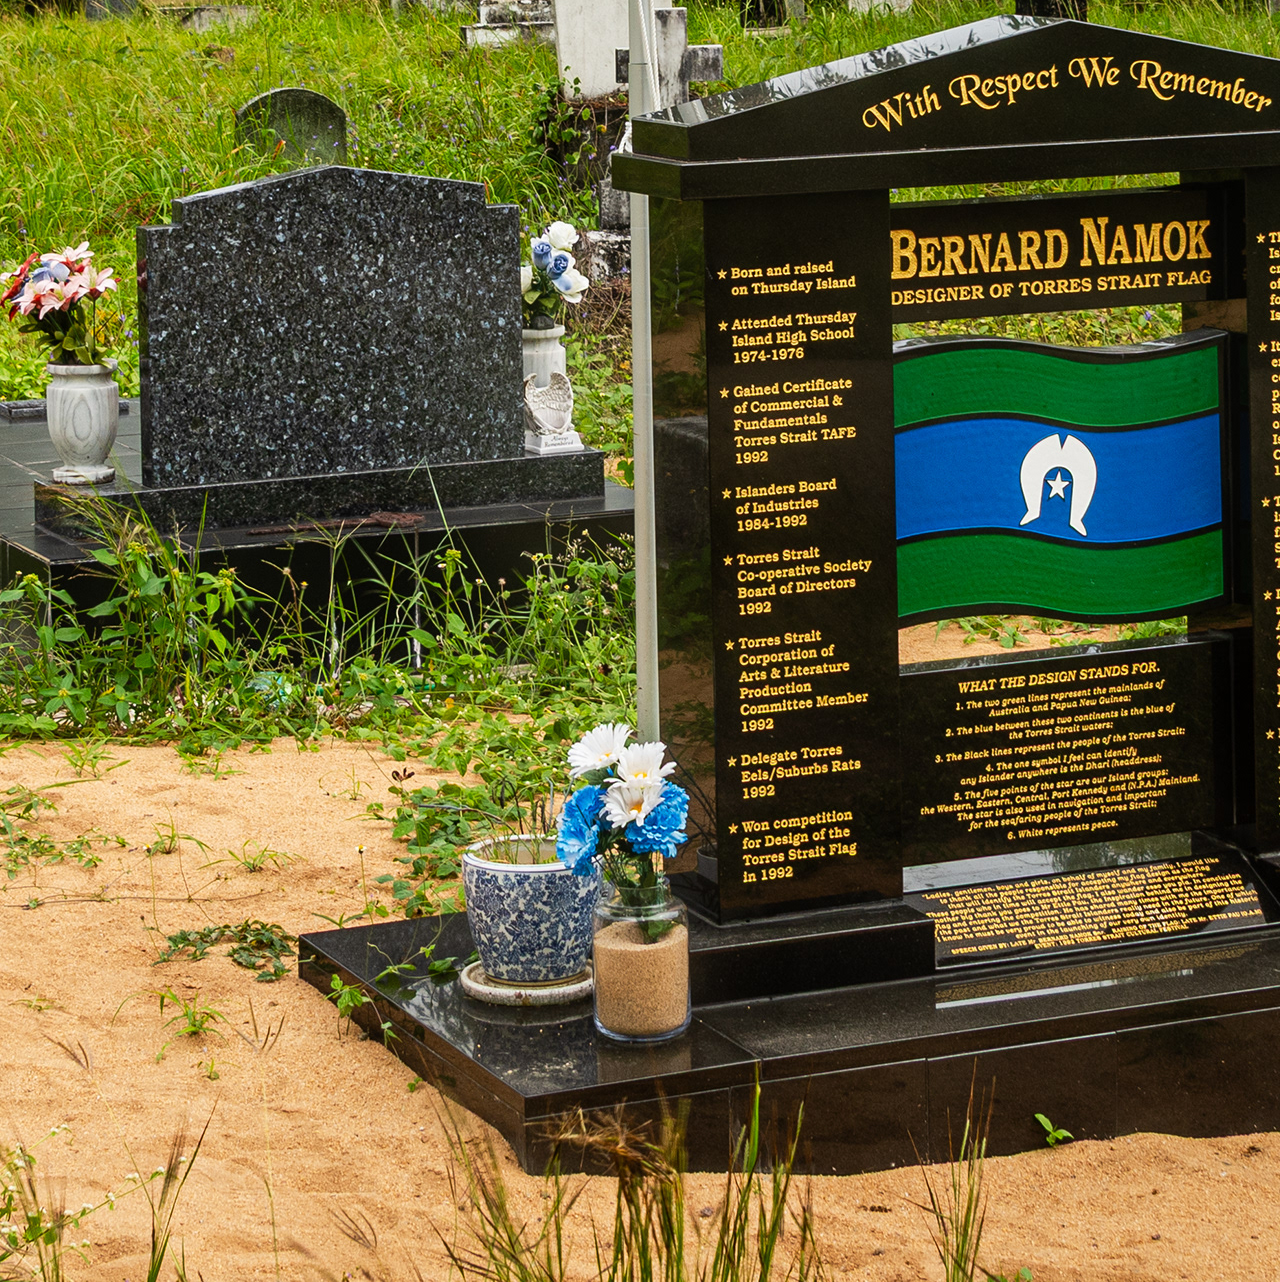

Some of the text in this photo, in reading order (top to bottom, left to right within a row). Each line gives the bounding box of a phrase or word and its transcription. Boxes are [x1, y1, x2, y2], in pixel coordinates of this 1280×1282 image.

[863, 56, 1272, 132] With Respect We Remember
[890, 216, 1212, 279] BERNARD NAMOK
[730, 260, 834, 278] Born and raised
[731, 275, 856, 295] on Thursday Island
[891, 270, 1212, 305] DESIGNER OF TORRES STRAIT FLAG
[731, 310, 856, 330] Attended Thursday
[732, 326, 854, 346] Island High School
[734, 346, 804, 363] 1974-1976
[733, 378, 852, 397] Gained Certificate
[733, 394, 842, 414] of Commercial &
[733, 412, 827, 430] Fundamentals
[734, 426, 856, 447] Torres Strait TAFE
[735, 450, 768, 464] 1992
[735, 478, 836, 498] Islanders Board
[736, 497, 818, 514] of Industries
[737, 514, 807, 531] 1984-1992
[736, 546, 820, 565] Torres Strait
[737, 559, 872, 582] Co-operative Society
[737, 578, 856, 598] Board of Directors
[739, 601, 771, 615] 1992
[738, 629, 821, 649] Torres Strait
[739, 644, 834, 666] Corporation of
[738, 662, 849, 682] Arts & Literature
[958, 661, 1160, 693] WHAT THE DESIGN STANDS FOR.
[739, 681, 812, 699] Production
[955, 679, 1165, 710] 1. The two green lines represent the mainlands of
[740, 692, 868, 715] Committee Member
[988, 704, 1030, 716] Australia
[1031, 702, 1048, 712] and
[1050, 700, 1077, 710] Papua
[1079, 698, 1096, 706] New
[741, 717, 774, 732] 1992
[740, 745, 842, 766] Delegate Torres
[741, 759, 861, 782] Eels/Suburbs Rats
[742, 784, 775, 799] 1992
[741, 810, 852, 832] Won competition
[742, 826, 850, 849] for Design of the
[742, 842, 856, 866] Torres Strait Flag
[1181, 859, 1204, 867] would
[742, 865, 793, 882] in 1992
